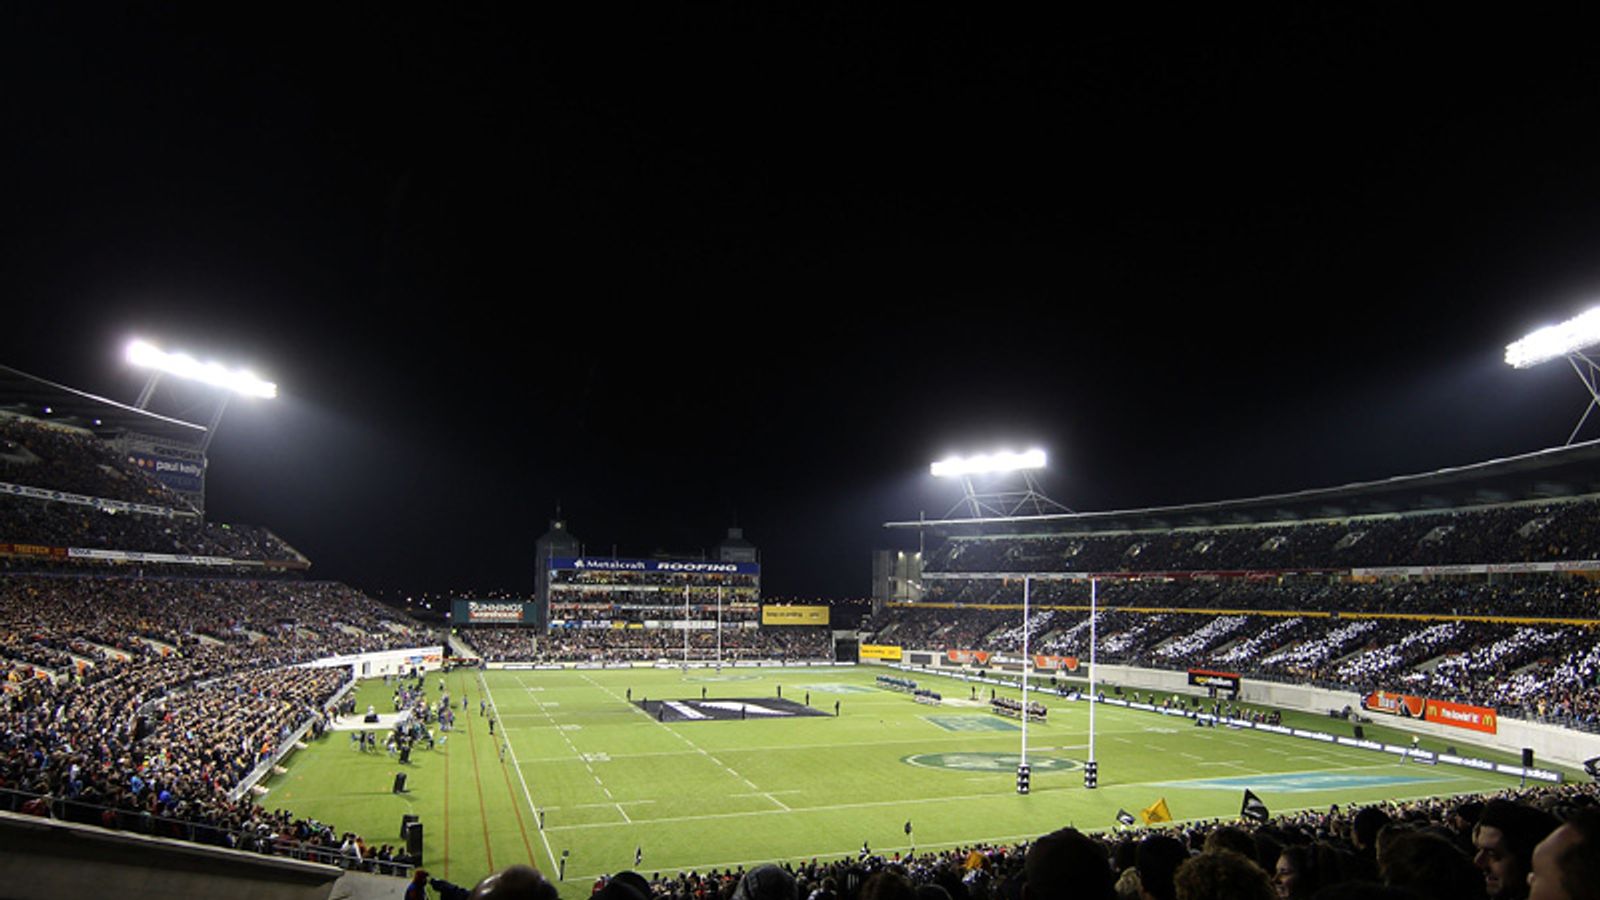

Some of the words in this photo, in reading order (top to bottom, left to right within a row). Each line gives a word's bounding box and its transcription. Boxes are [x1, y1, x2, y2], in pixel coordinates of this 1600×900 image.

[156, 461, 179, 472] paul
[180, 463, 201, 477] kelly
[586, 561, 646, 569] Metalcraft
[657, 562, 738, 572] ROOFING
